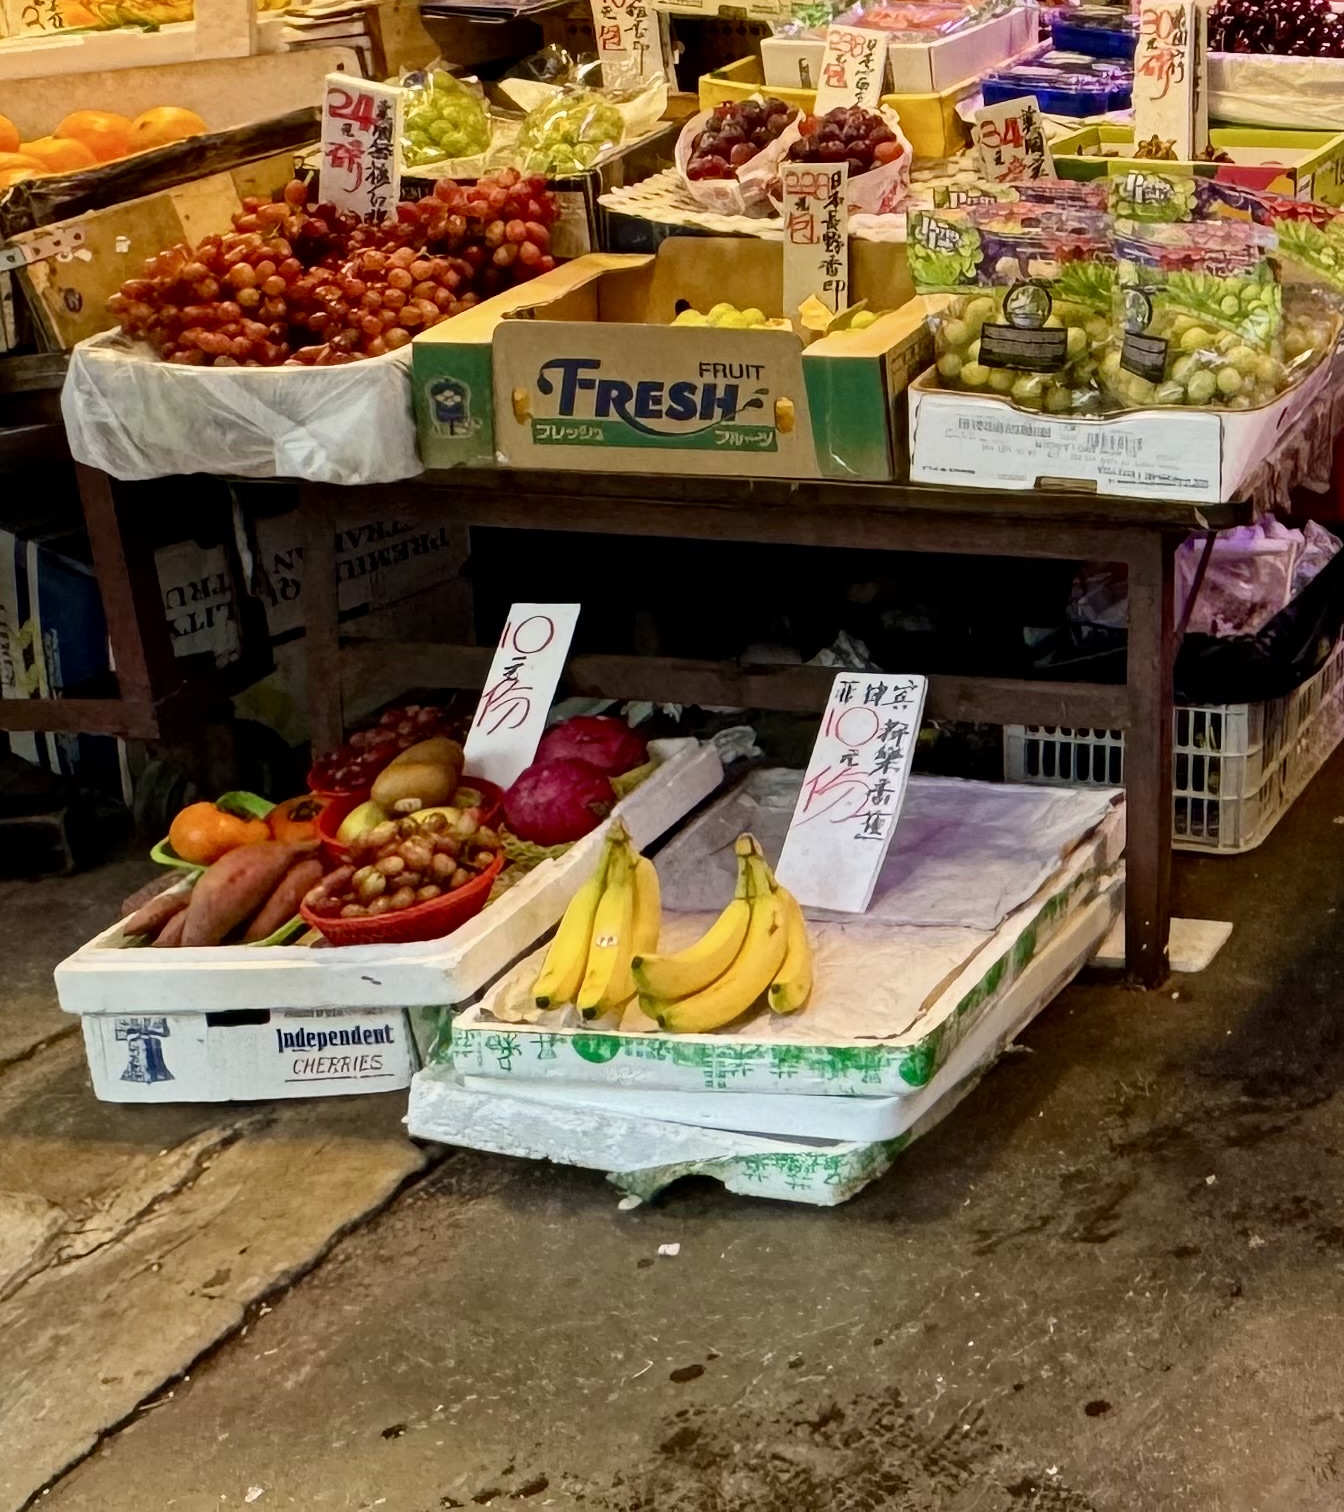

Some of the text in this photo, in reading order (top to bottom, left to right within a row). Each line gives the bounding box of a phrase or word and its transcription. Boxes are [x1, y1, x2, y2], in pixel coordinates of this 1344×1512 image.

[699, 361, 767, 381] FRUIT
[538, 357, 740, 424] FRESH
[501, 614, 555, 655] 10
[826, 706, 881, 748] 10
[275, 1023, 396, 1054] Independent
[292, 1054, 386, 1076] CHERRIES
